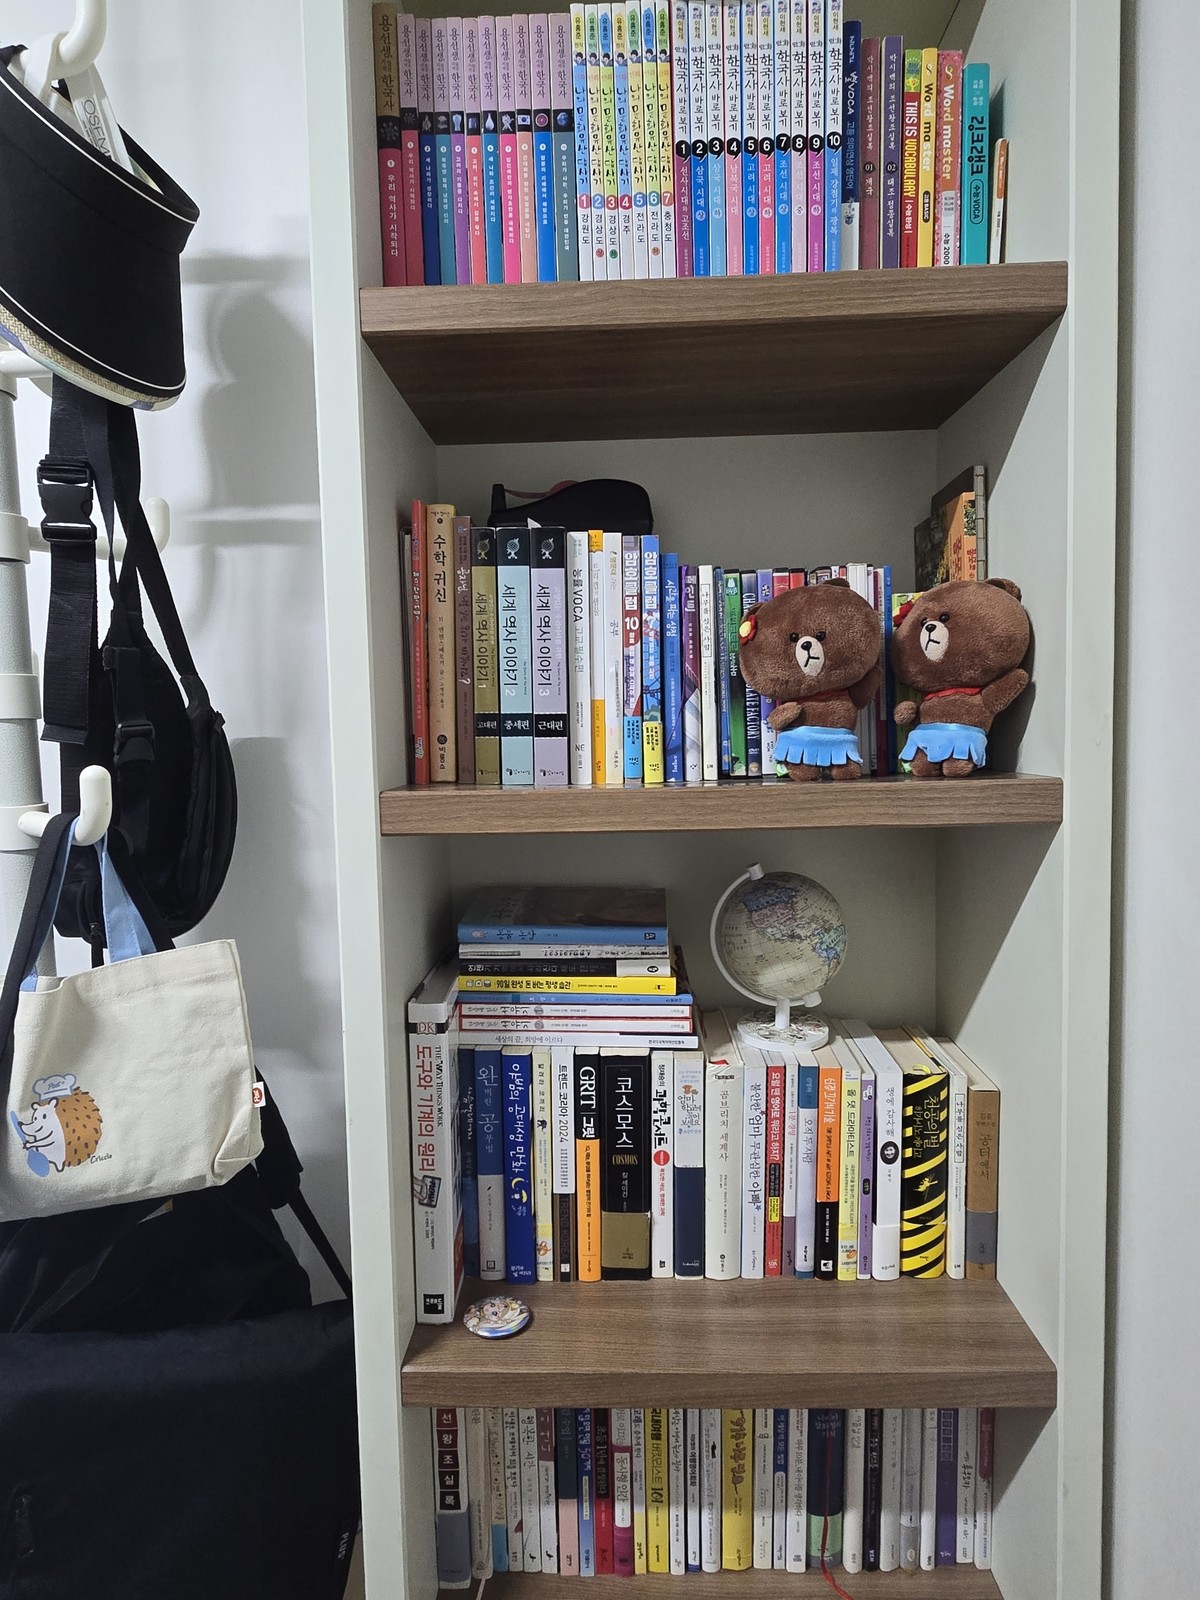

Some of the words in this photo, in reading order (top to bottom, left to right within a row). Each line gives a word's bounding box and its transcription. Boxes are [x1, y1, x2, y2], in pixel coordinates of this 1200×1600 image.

[675, 56, 688, 94] 한국사
[828, 48, 843, 86] 한국사
[382, 75, 396, 111] 한국사
[483, 73, 495, 99] 한국사
[556, 72, 568, 99] 한국사
[923, 82, 934, 118] Word
[943, 83, 955, 126] Word
[865, 95, 873, 151] 조선왕조실록
[888, 95, 896, 151] 조선왕조실록
[906, 101, 918, 124] THIS
[780, 137, 787, 148] 7
[796, 138, 803, 149] 8
[812, 138, 819, 149] 9
[829, 135, 840, 146] 10
[906, 126, 917, 137] IS
[712, 142, 719, 152] 3
[730, 142, 737, 153] 4
[763, 140, 770, 151] 6
[922, 121, 932, 172] master
[942, 128, 953, 180] master
[968, 115, 987, 176] 링크랭크
[695, 166, 705, 186] 삼국
[811, 161, 821, 178] 조선
[904, 138, 917, 198] VOCABULARY
[387, 175, 397, 192] 우리
[812, 182, 821, 201] 시대
[388, 195, 398, 220] 역사가
[582, 197, 587, 207] 1
[637, 195, 643, 205] 5
[650, 194, 657, 204] 6
[664, 194, 670, 204] 7
[696, 189, 705, 207] 시대
[972, 199, 980, 219] VOCA
[581, 214, 591, 245] 강원도
[595, 214, 604, 245] 경상도
[608, 214, 617, 246] 경상도
[622, 214, 631, 234] 경주
[636, 213, 645, 243] 전라도
[651, 211, 660, 242] 전라도
[664, 212, 673, 243] 충청도
[680, 214, 690, 241] 고조선
[389, 224, 399, 257] 시작되다
[943, 233, 950, 247] 수능
[432, 533, 447, 567] 수학
[432, 572, 447, 604] 귀신
[502, 584, 516, 611] 세계
[537, 584, 551, 611] 세계
[664, 579, 679, 604] 시간을
[475, 591, 487, 616] 세계
[572, 588, 584, 623] VOCA
[666, 604, 679, 620] 파는
[475, 618, 488, 644] 역사
[502, 615, 517, 643] 역사
[537, 614, 551, 643] 역사
[609, 621, 620, 637] 공부
[624, 616, 639, 630] 10
[665, 621, 678, 638] 상점
[475, 648, 489, 682] 이야기
[502, 647, 518, 686] 이야기
[537, 647, 552, 686] 이야기
[505, 687, 516, 696] 2
[539, 688, 550, 697] 3
[476, 720, 497, 730] 고대편
[503, 719, 530, 731] 중세편
[537, 719, 564, 731] 근대편
[747, 711, 760, 740] FACTORY
[574, 744, 585, 752] NE
[496, 979, 510, 990] 90일
[510, 979, 524, 990] 완성
[558, 979, 572, 990] 습관
[500, 1005, 531, 1016] 서유기
[417, 1022, 435, 1033] DK
[500, 1019, 531, 1030] 서유기
[494, 1034, 511, 1045] 세상의
[524, 1035, 543, 1045] 희망에
[544, 1034, 563, 1045] 이르다
[435, 1046, 443, 1059] THE
[415, 1045, 435, 1091] 도구와
[434, 1059, 444, 1078] WAY
[557, 1064, 568, 1091] 트렌드
[657, 1063, 666, 1087] 정재승의
[435, 1079, 444, 1103] THINGS
[509, 1063, 524, 1100] 야밤의
[579, 1066, 596, 1109] GRIT
[824, 1077, 837, 1091] 신경
[848, 1088, 857, 1096] 올
[558, 1092, 570, 1116] 코리아
[749, 1082, 762, 1111] 불안한
[848, 1100, 857, 1109] 댓
[886, 1086, 895, 1105] 생에
[417, 1096, 436, 1138] 기계의
[435, 1104, 444, 1127] WORK
[615, 1076, 634, 1148] 코스모스
[718, 1090, 730, 1129] 곰브리치
[770, 1098, 781, 1120] 영어로
[824, 1110, 836, 1124] 기술
[913, 1106, 924, 1136] 히가시노
[923, 1095, 940, 1134] 천공의
[509, 1104, 525, 1144] 공대생
[558, 1116, 568, 1143] 2024
[582, 1117, 595, 1139] 그릿
[652, 1115, 672, 1149] 콘서트
[748, 1114, 763, 1140] 엄마
[770, 1122, 781, 1142] 뭐라고
[802, 1118, 813, 1138] 오직
[846, 1110, 857, 1158] 드라마티스트
[886, 1108, 895, 1138] 감사해
[718, 1134, 729, 1163] 세계사
[770, 1143, 781, 1162] 하지?
[923, 1135, 940, 1149] 벌
[417, 1142, 436, 1173] 원리
[509, 1148, 526, 1173] 만화
[611, 1154, 638, 1166] COSMOS
[748, 1141, 761, 1179] 무관심한
[802, 1149, 813, 1164] 사람
[748, 1181, 762, 1205] 아빠
[521, 1415, 535, 1446] 행복한
[523, 1451, 536, 1469] 시간
[650, 1442, 663, 1485] 버킷리스트
[616, 1484, 630, 1504] 인간
[651, 1486, 663, 1504] 101
